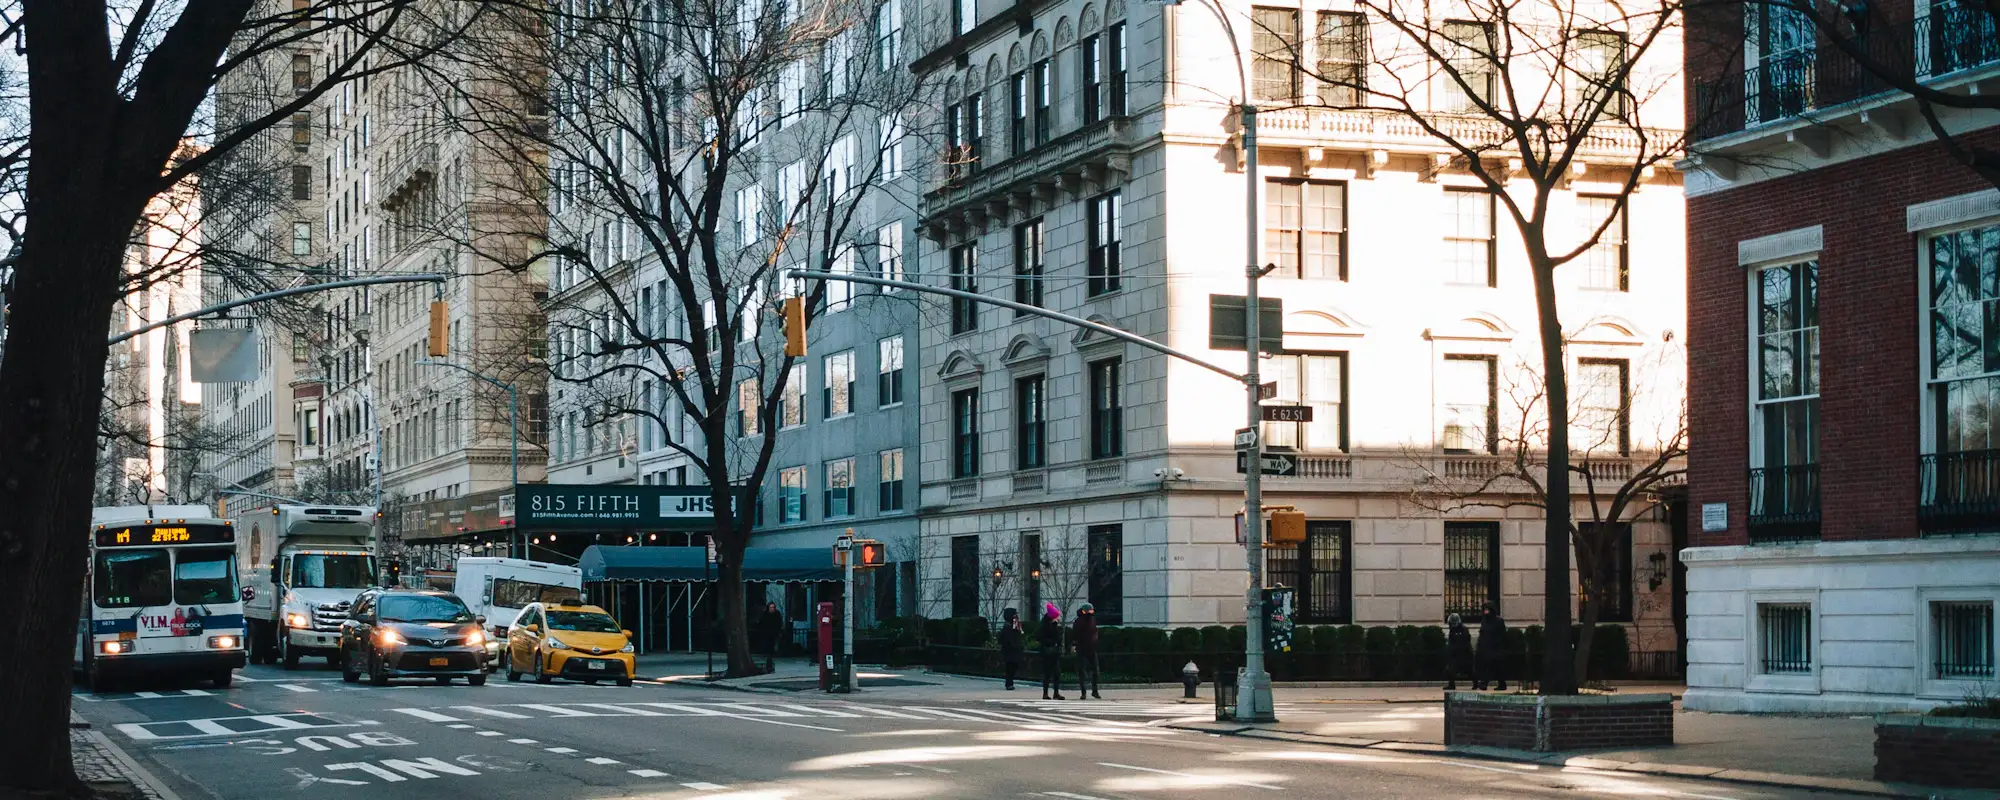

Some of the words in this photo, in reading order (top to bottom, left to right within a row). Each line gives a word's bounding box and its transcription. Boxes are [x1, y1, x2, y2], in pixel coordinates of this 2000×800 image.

[1272, 409, 1277, 420] E
[1280, 409, 1291, 420] 62
[1294, 409, 1303, 421] St
[1270, 461, 1288, 470] WAY
[532, 495, 565, 511] 815
[577, 495, 639, 511] FIFTH
[235, 731, 418, 755] BUS
